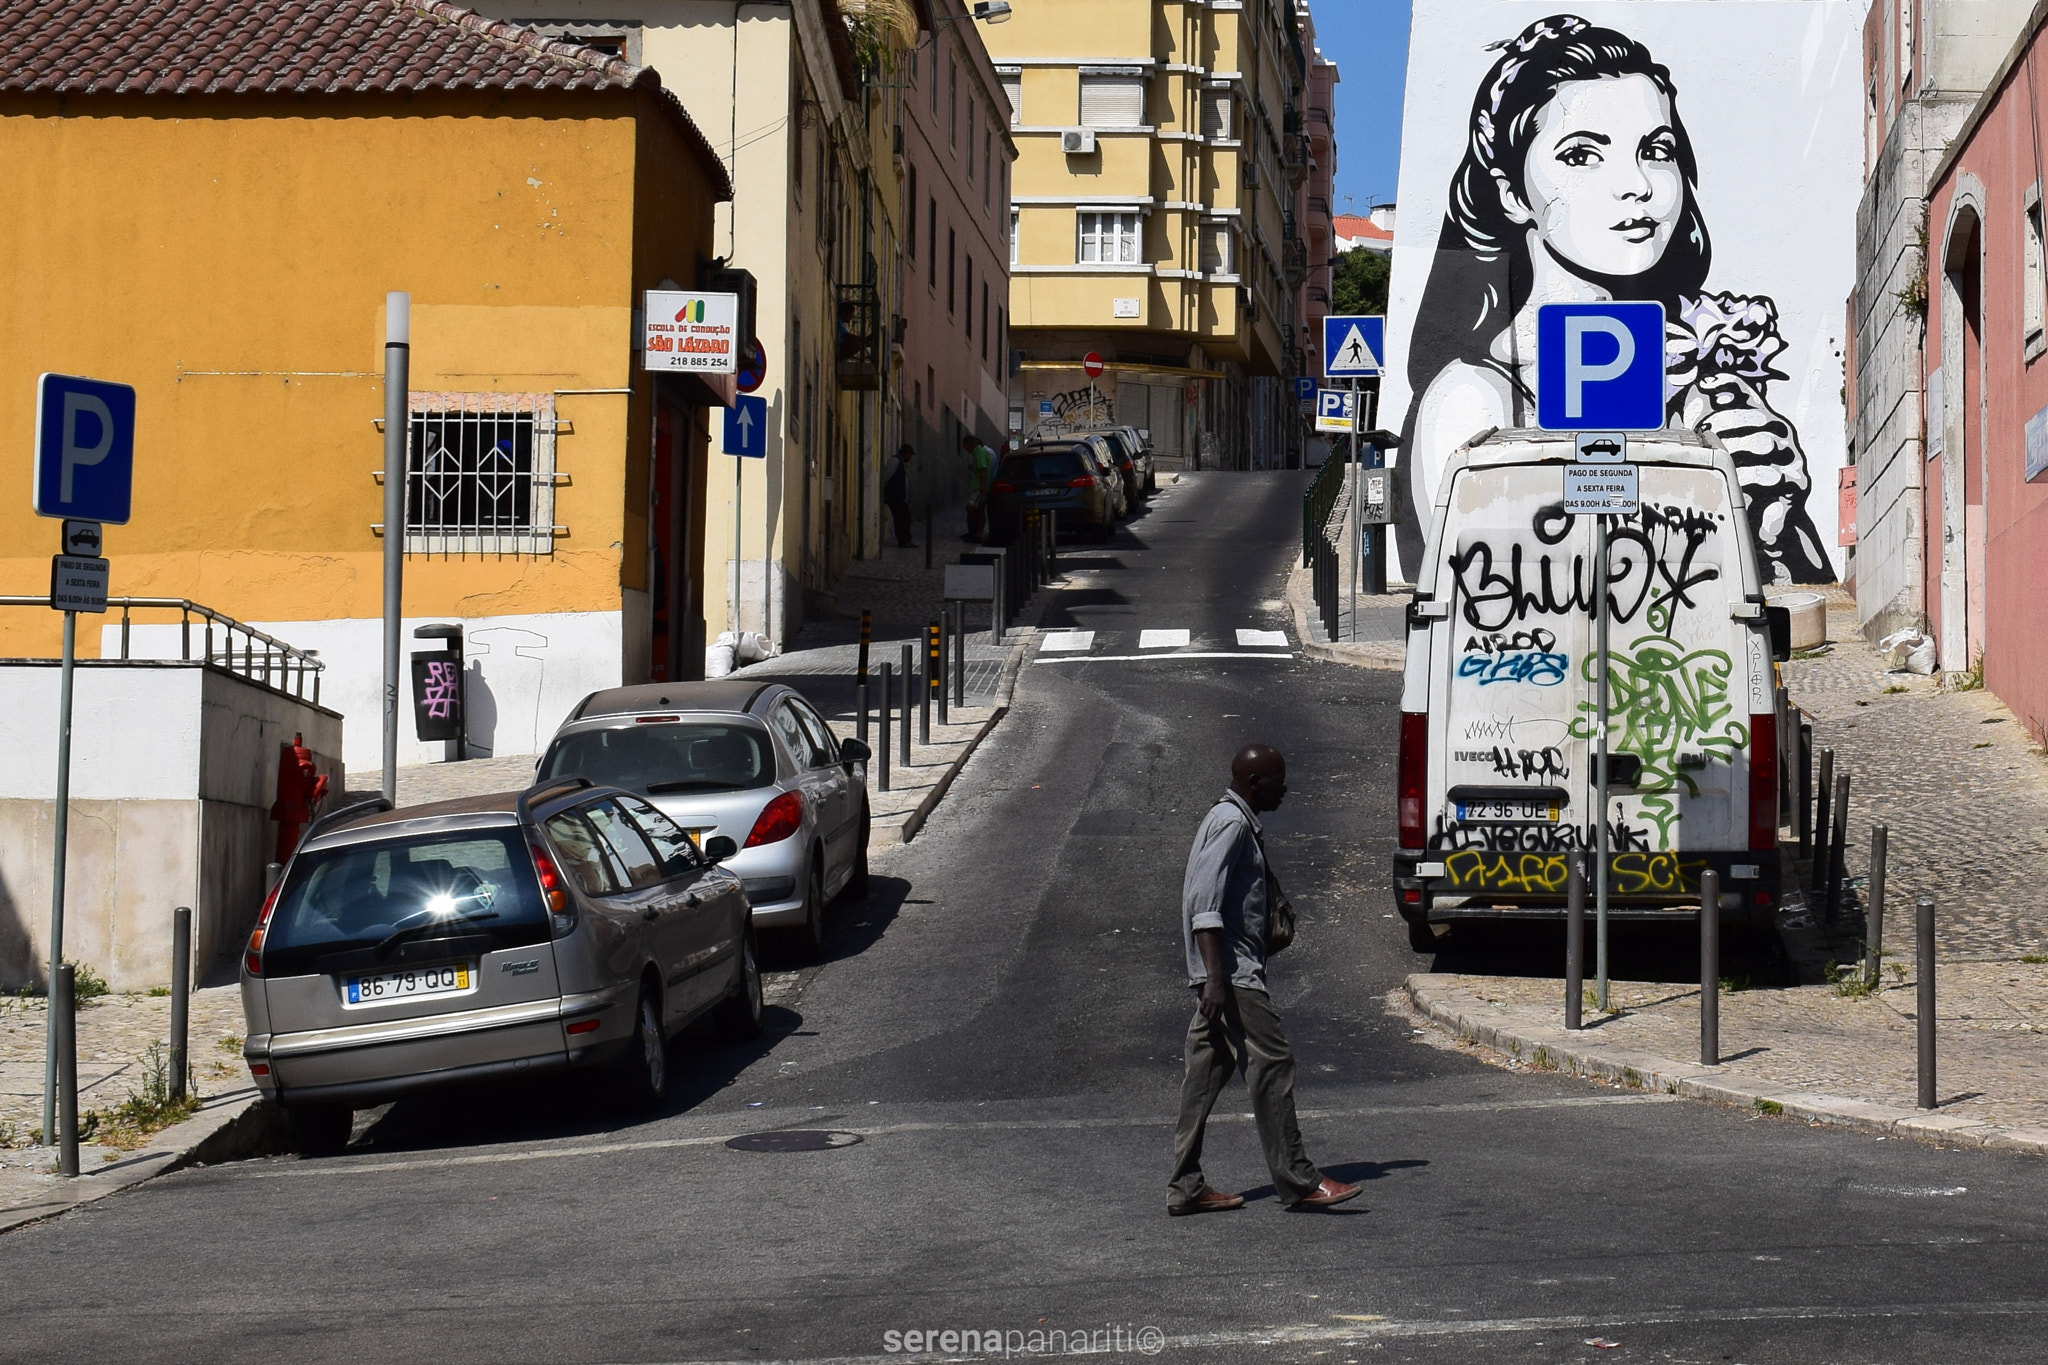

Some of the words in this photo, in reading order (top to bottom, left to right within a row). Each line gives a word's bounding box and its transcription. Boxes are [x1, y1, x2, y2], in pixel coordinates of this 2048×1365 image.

[648, 323, 675, 332] ESCOLA
[647, 335, 673, 352] SÃO
[678, 336, 729, 354] LÁZARO
[670, 357, 687, 366] 218
[690, 357, 708, 366] 885
[710, 358, 728, 367] 254
[1564, 315, 1635, 418] P
[1300, 379, 1312, 397] P
[1321, 393, 1340, 416] P
[60, 391, 114, 504] P
[1374, 450, 1381, 465] P
[1568, 469, 1587, 477] PAGO
[1589, 469, 1598, 477] DE
[1600, 469, 1633, 477] SEGUNDA
[1565, 500, 1579, 508] DAS
[1580, 500, 1600, 508] 9.00H
[1454, 751, 1494, 761] IVECO
